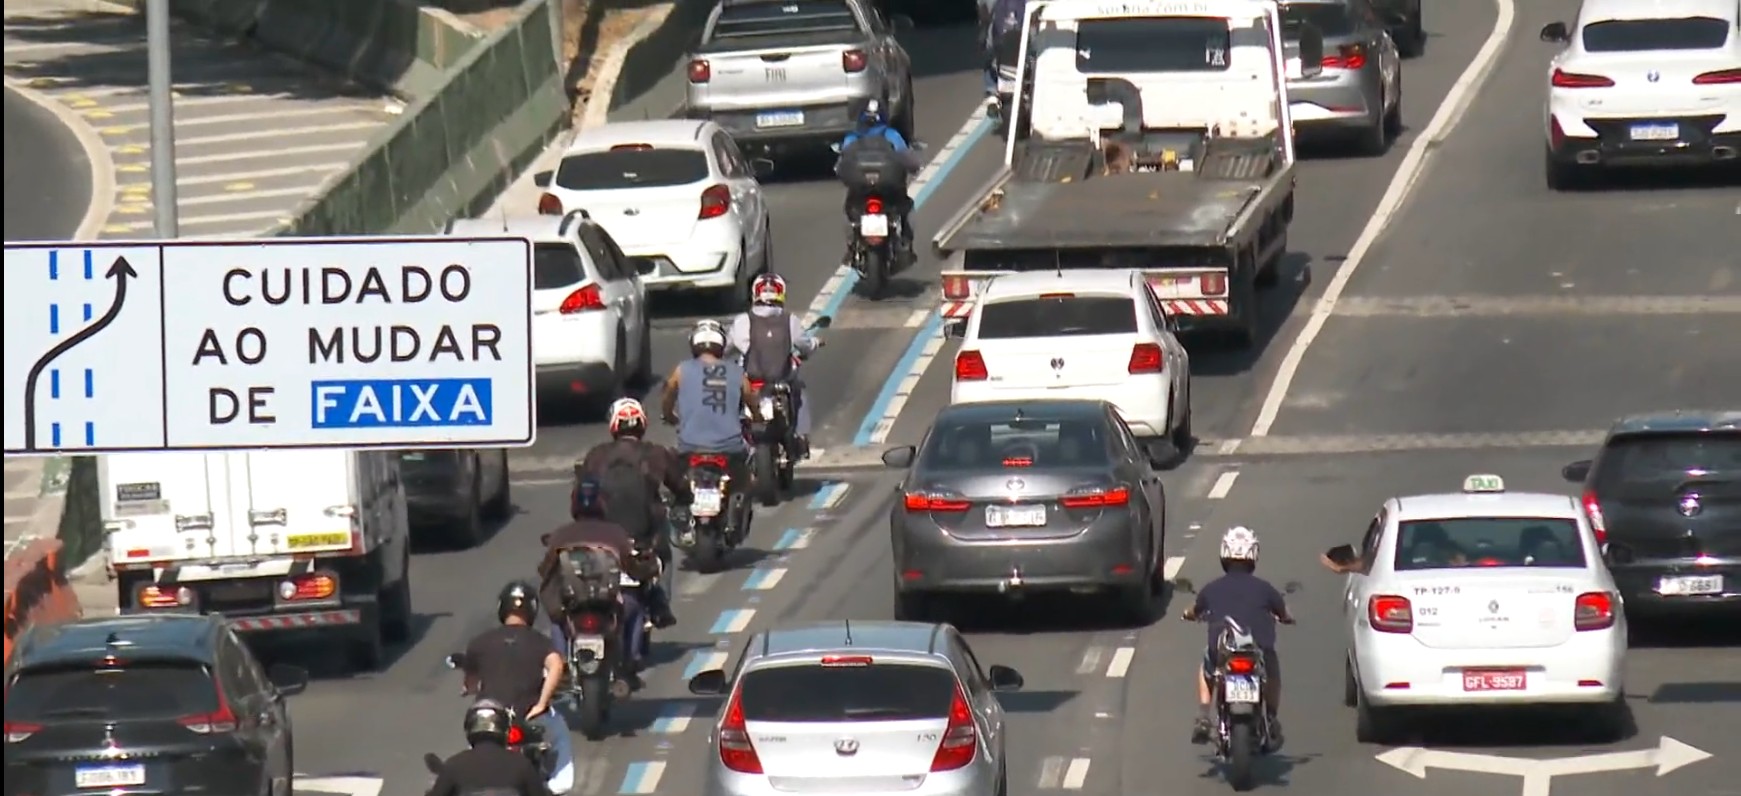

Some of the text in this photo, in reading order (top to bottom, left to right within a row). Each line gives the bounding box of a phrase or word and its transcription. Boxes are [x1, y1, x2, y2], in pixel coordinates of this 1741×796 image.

[222, 264, 471, 306] CUIDADO
[192, 323, 502, 366] AO MUDAR
[209, 383, 487, 425] DE FAIXA
[702, 365, 727, 415] SURF
[1470, 477, 1499, 490] TAXI
